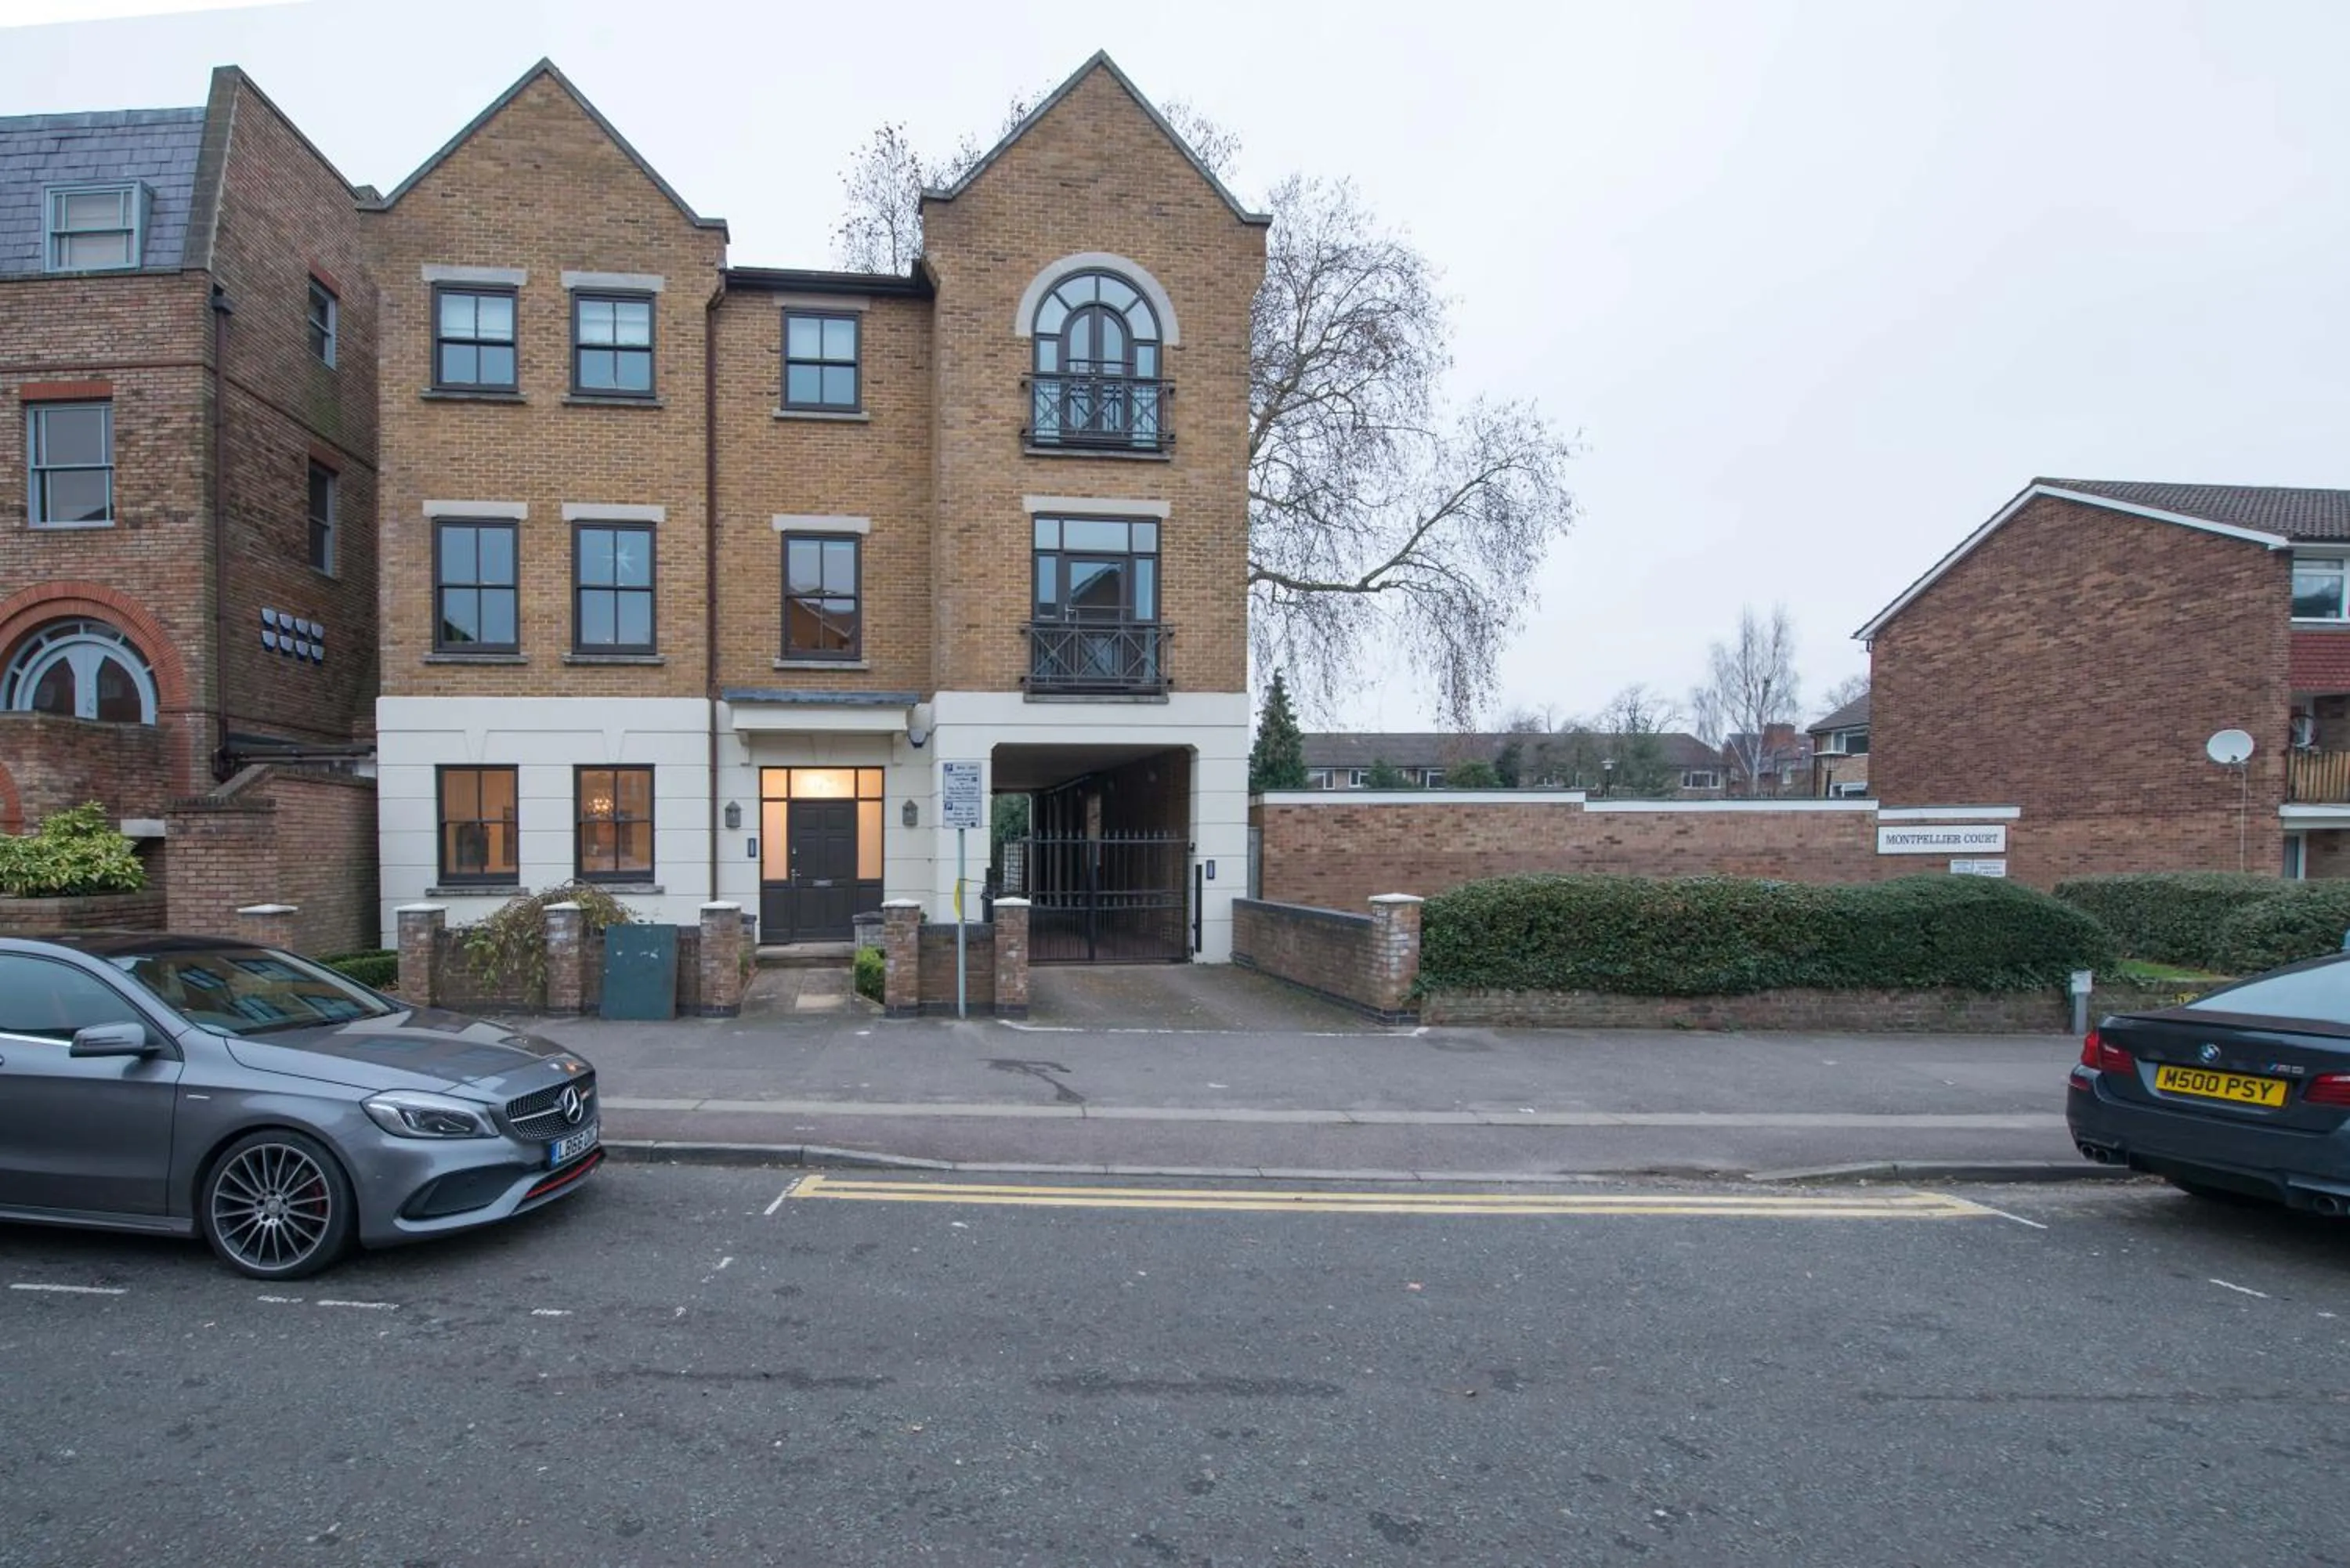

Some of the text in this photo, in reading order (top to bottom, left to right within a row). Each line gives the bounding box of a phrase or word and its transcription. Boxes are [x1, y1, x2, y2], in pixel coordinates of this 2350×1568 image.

[1885, 833, 1998, 844] MONTPELLIER COURT
[2164, 1069, 2274, 1100] M500 PSY
